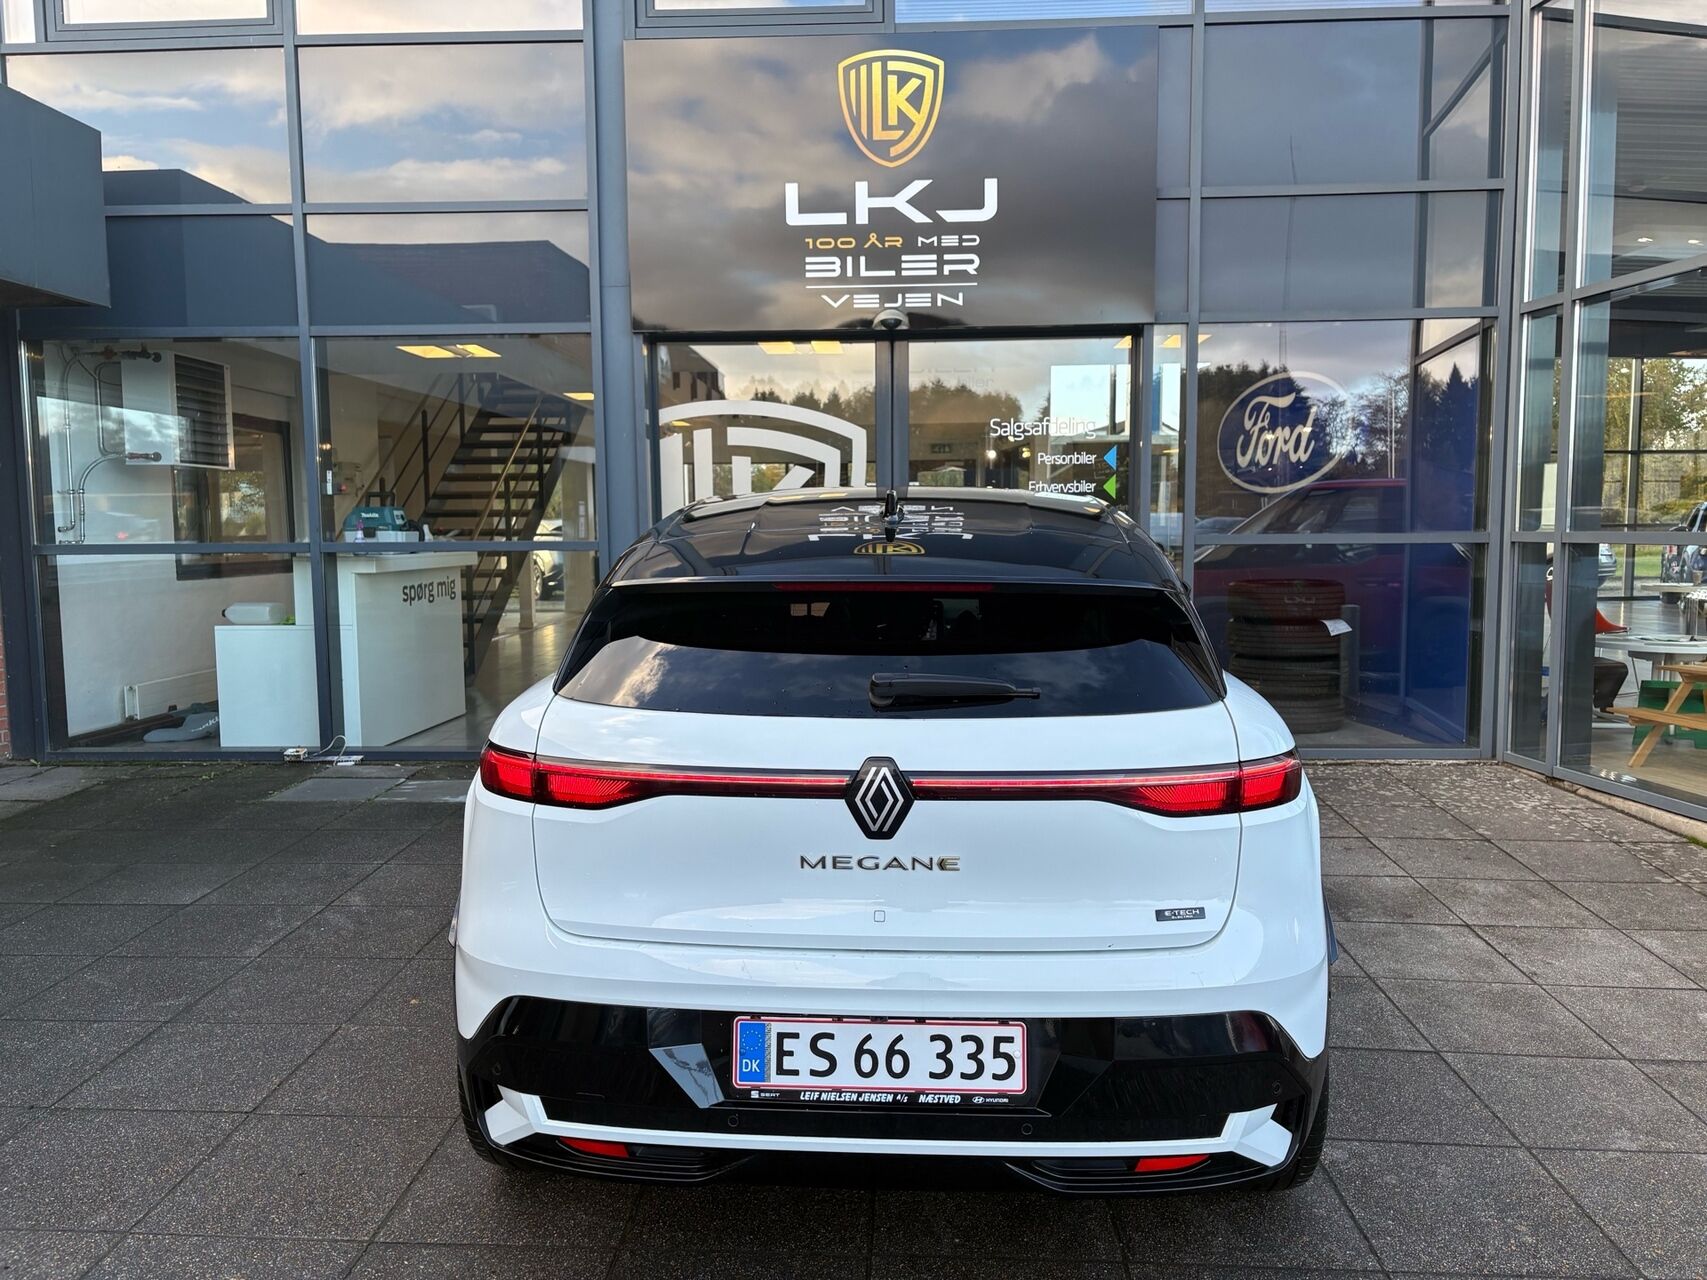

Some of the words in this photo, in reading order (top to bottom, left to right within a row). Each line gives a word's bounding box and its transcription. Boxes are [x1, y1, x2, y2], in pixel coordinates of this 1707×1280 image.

[785, 178, 998, 226] LKJ
[805, 237, 856, 249] 100
[863, 233, 903, 248] ÅR
[918, 235, 980, 247] MED
[805, 253, 981, 278] BILER
[820, 292, 964, 308] VEJEN
[990, 418, 1096, 441] Salgsafdeling
[1236, 392, 1318, 468] Ford
[1037, 451, 1097, 465] Personbiler
[1028, 480, 1097, 493] Erhvervsbiler
[402, 581, 434, 606] spørg
[437, 576, 457, 600] mig
[800, 855, 961, 872] MEGANE
[776, 1031, 838, 1077] ES
[854, 1033, 910, 1079] 66
[928, 1034, 1016, 1081] 335
[742, 1058, 760, 1073] DK
[800, 1091, 820, 1101] LEIF
[820, 1092, 858, 1102] NIELSEN
[859, 1093, 893, 1103] JENSEN
[919, 1094, 961, 1104] NÆSTVED
